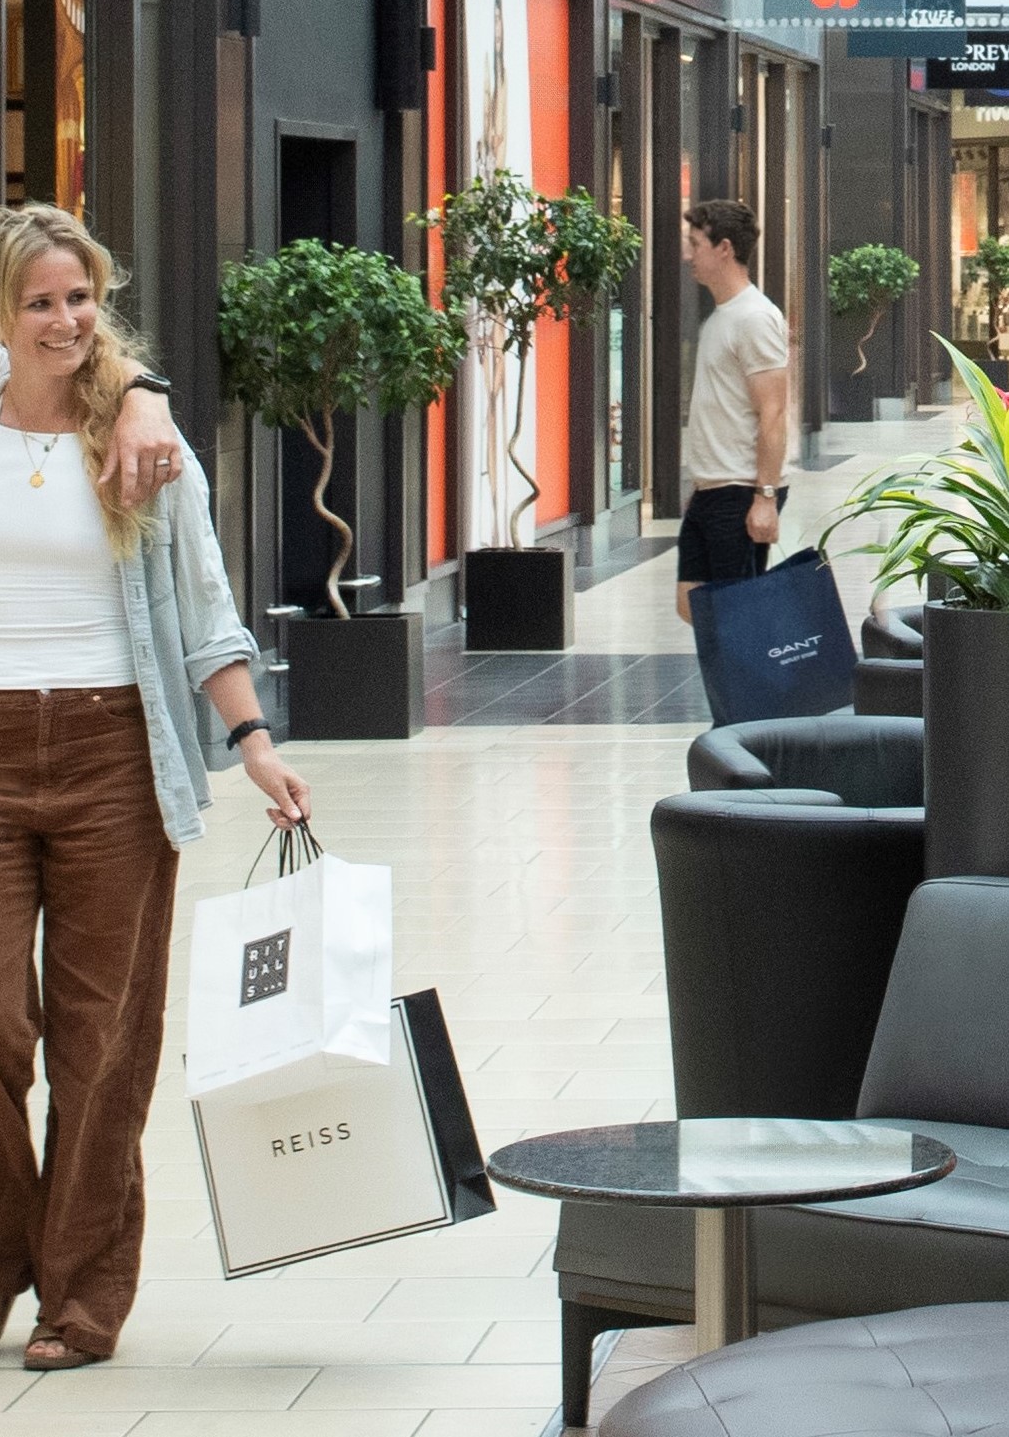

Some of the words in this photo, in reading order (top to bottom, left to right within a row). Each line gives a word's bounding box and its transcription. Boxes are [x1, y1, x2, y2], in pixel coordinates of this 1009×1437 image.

[951, 62, 996, 72] LONDON
[768, 634, 824, 658] GANT
[270, 1123, 351, 1157] REISS
